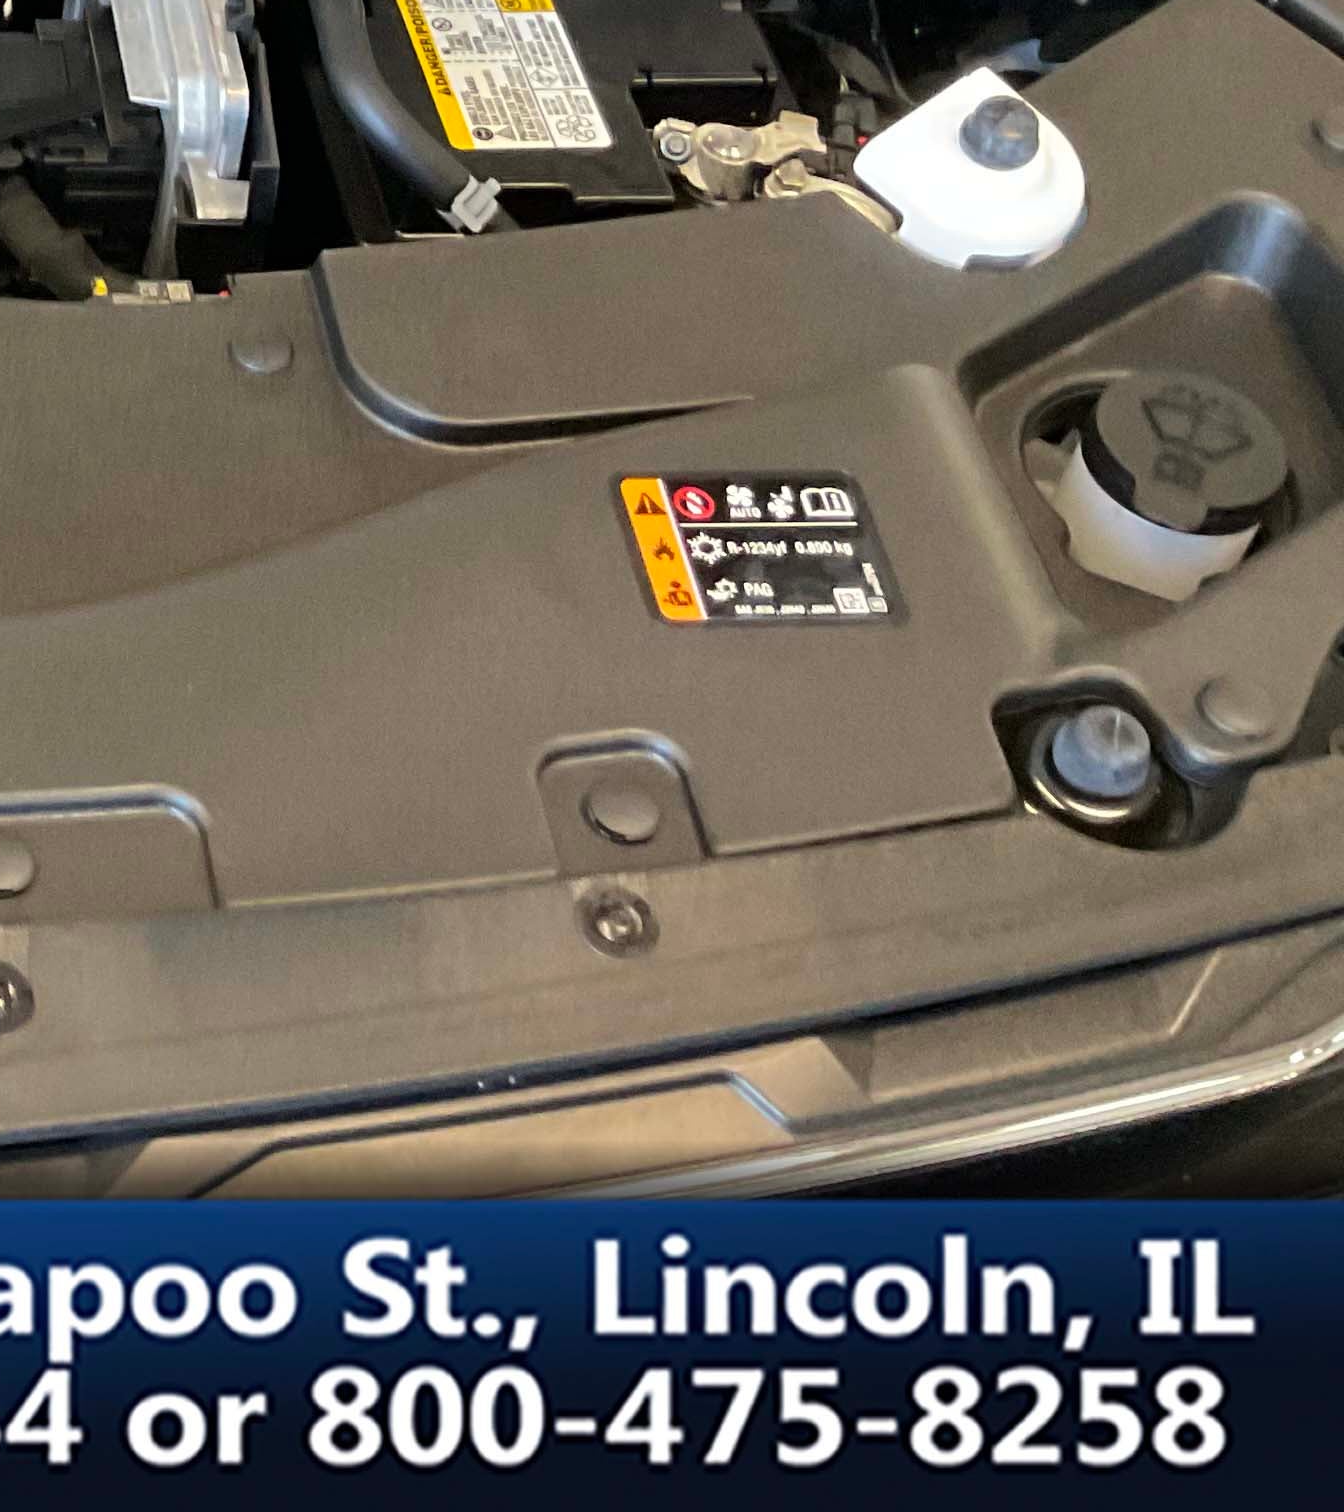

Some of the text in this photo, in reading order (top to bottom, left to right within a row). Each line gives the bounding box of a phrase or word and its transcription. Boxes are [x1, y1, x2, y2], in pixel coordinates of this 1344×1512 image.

[730, 506, 762, 519] AUTO
[726, 540, 788, 557] R-1234yf
[833, 540, 854, 556] kg
